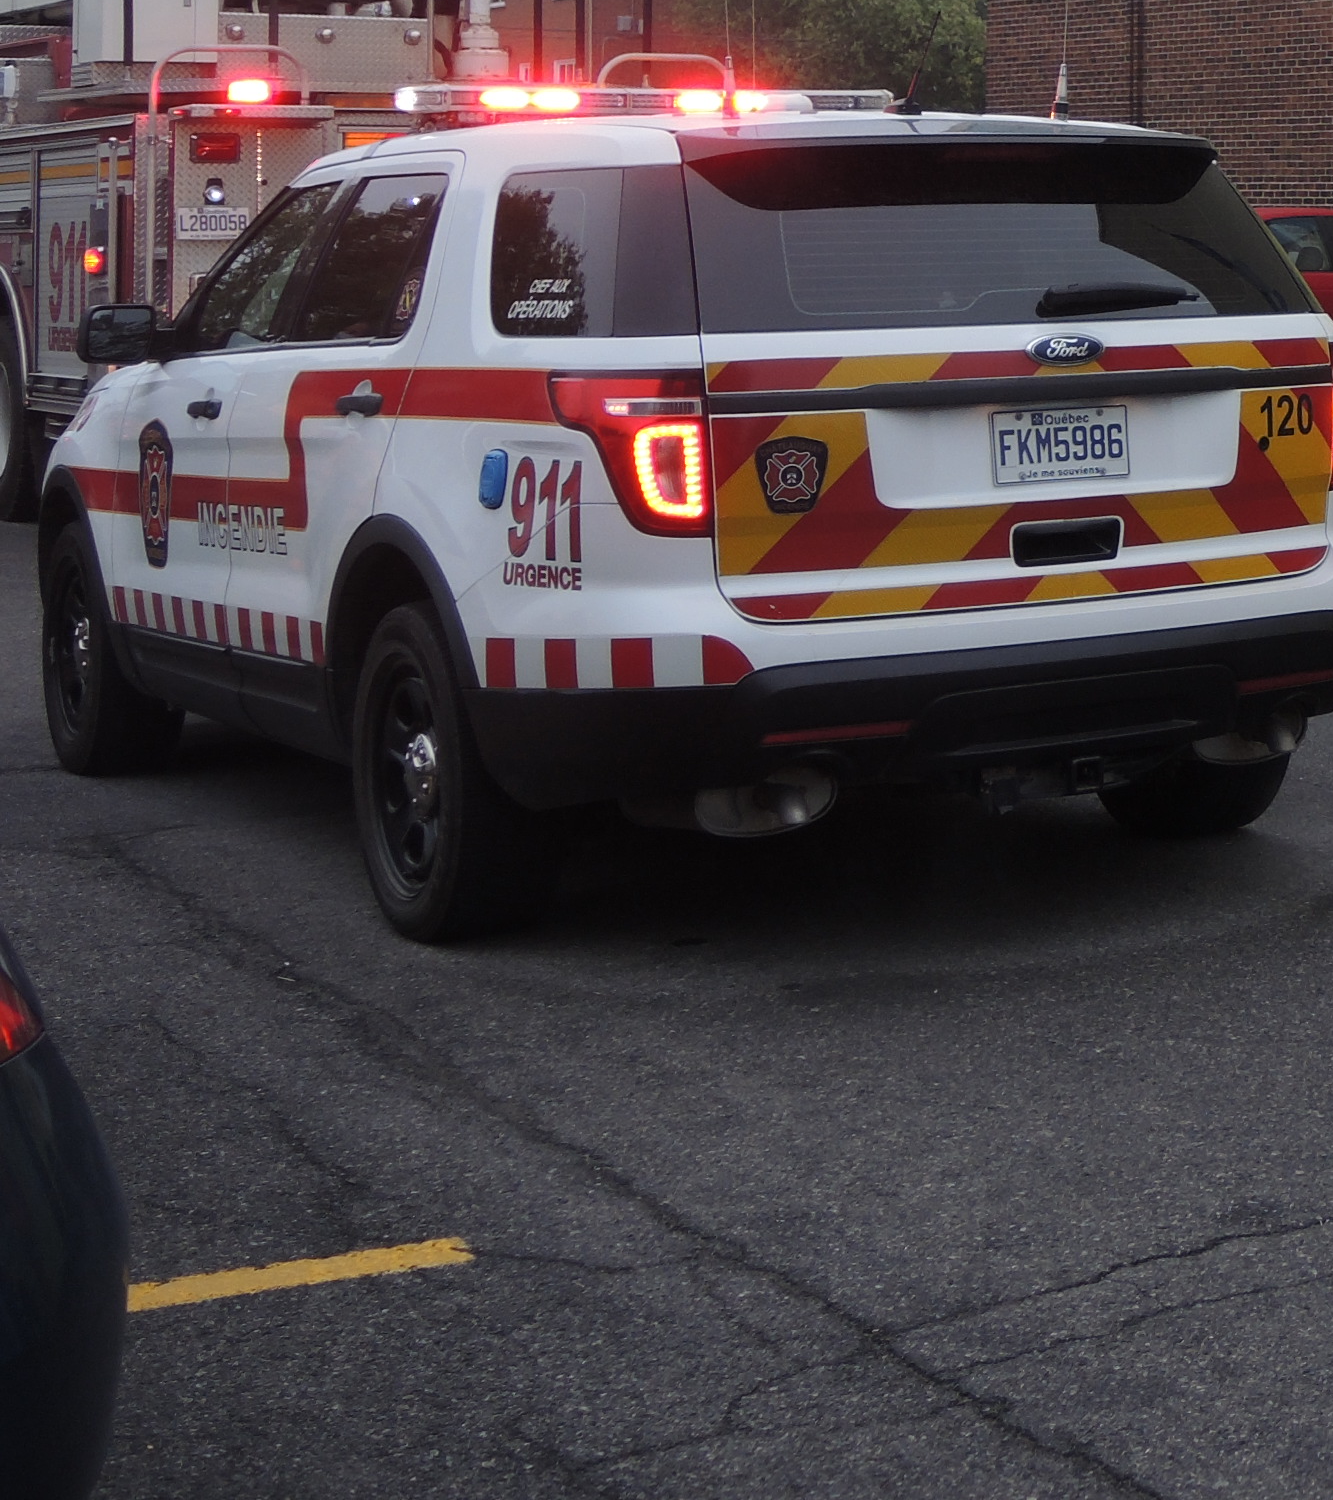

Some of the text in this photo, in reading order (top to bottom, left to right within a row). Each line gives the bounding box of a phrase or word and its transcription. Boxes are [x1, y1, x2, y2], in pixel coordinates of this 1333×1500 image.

[48, 220, 87, 323] 911
[529, 278, 572, 294] CHEF AUX
[507, 295, 574, 319] OPÉRATIONS
[48, 326, 79, 352] URGEN
[1046, 338, 1089, 358] Ford
[1045, 412, 1090, 425] Québec
[1260, 393, 1313, 438] 120
[998, 423, 1124, 466] FKM5986
[507, 455, 583, 563] 911
[197, 501, 288, 556] INCENDIE
[502, 561, 583, 591] URGENCE
